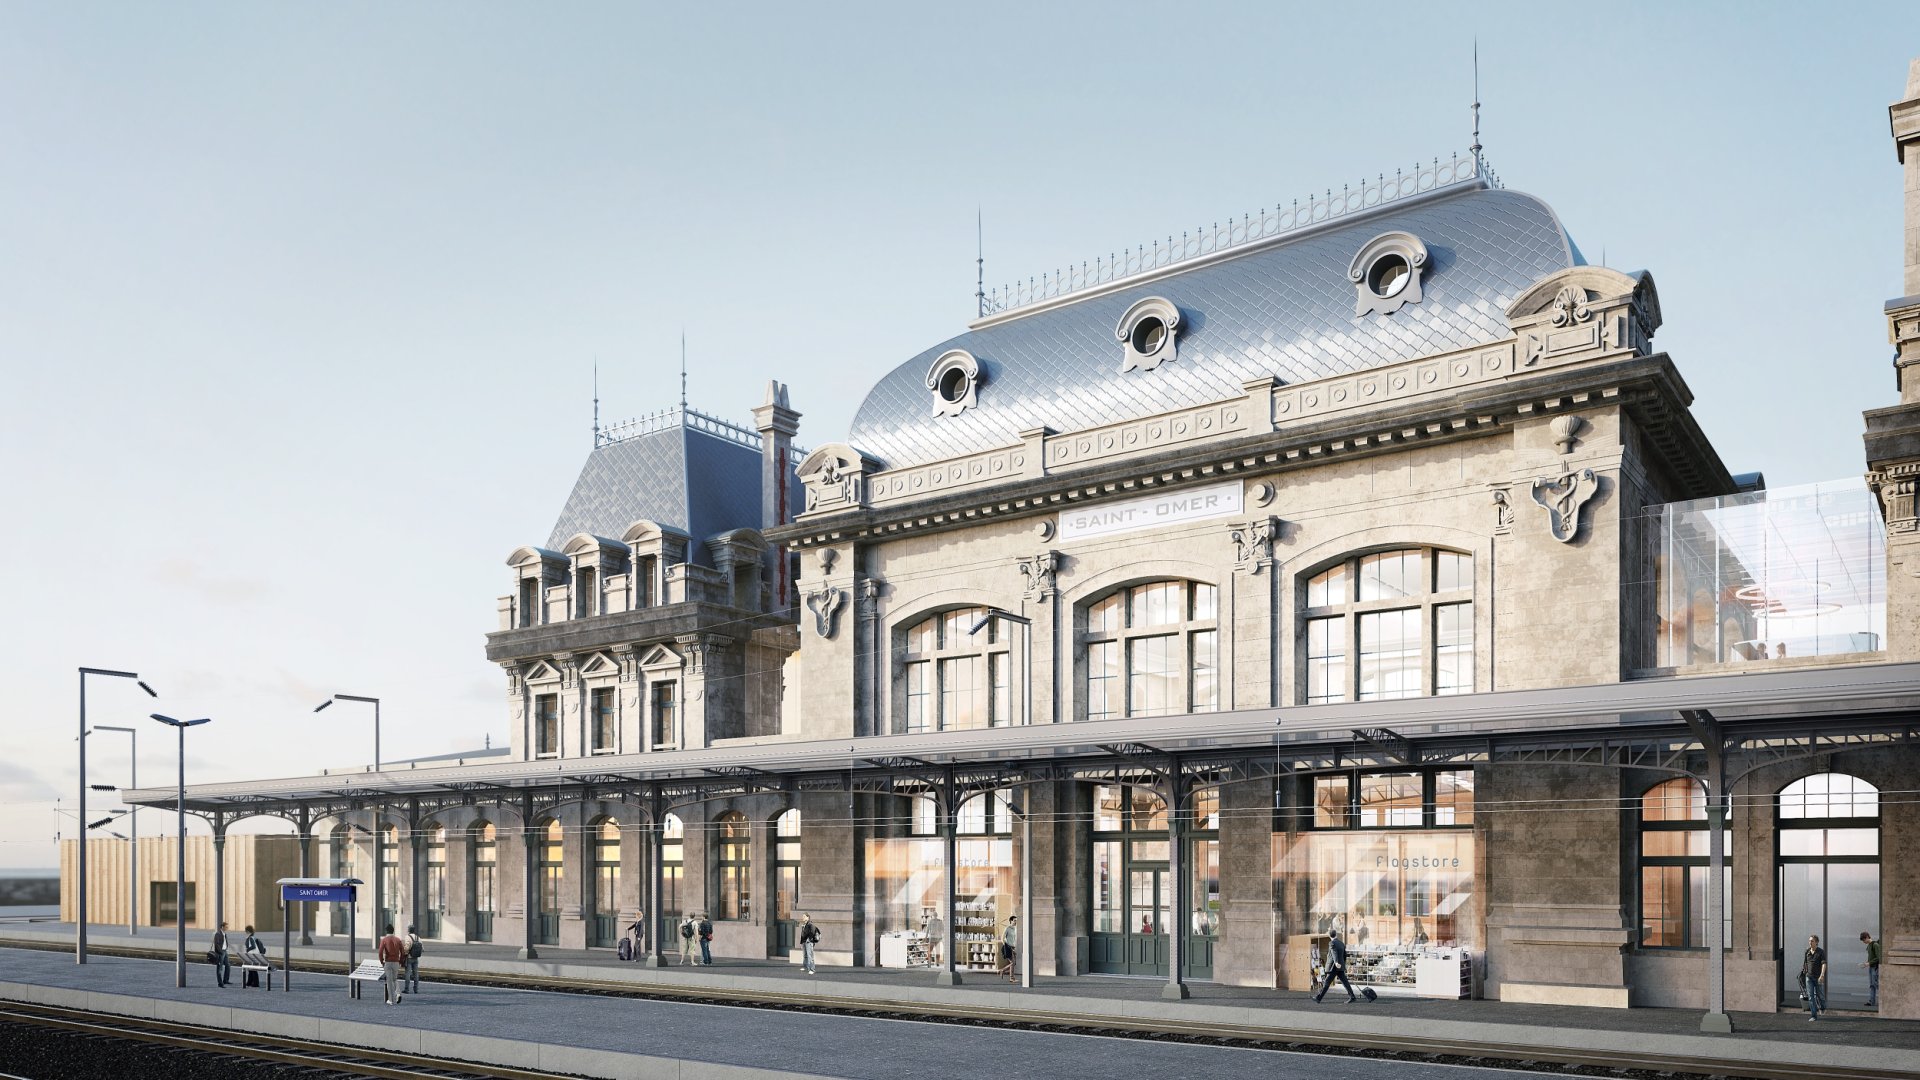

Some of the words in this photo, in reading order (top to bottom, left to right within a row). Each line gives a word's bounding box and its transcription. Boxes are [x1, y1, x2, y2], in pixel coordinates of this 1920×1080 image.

[1076, 508, 1137, 529] SAINT
[1156, 494, 1218, 516] OMER
[934, 857, 990, 867] flstore
[1376, 855, 1459, 870] flagstore
